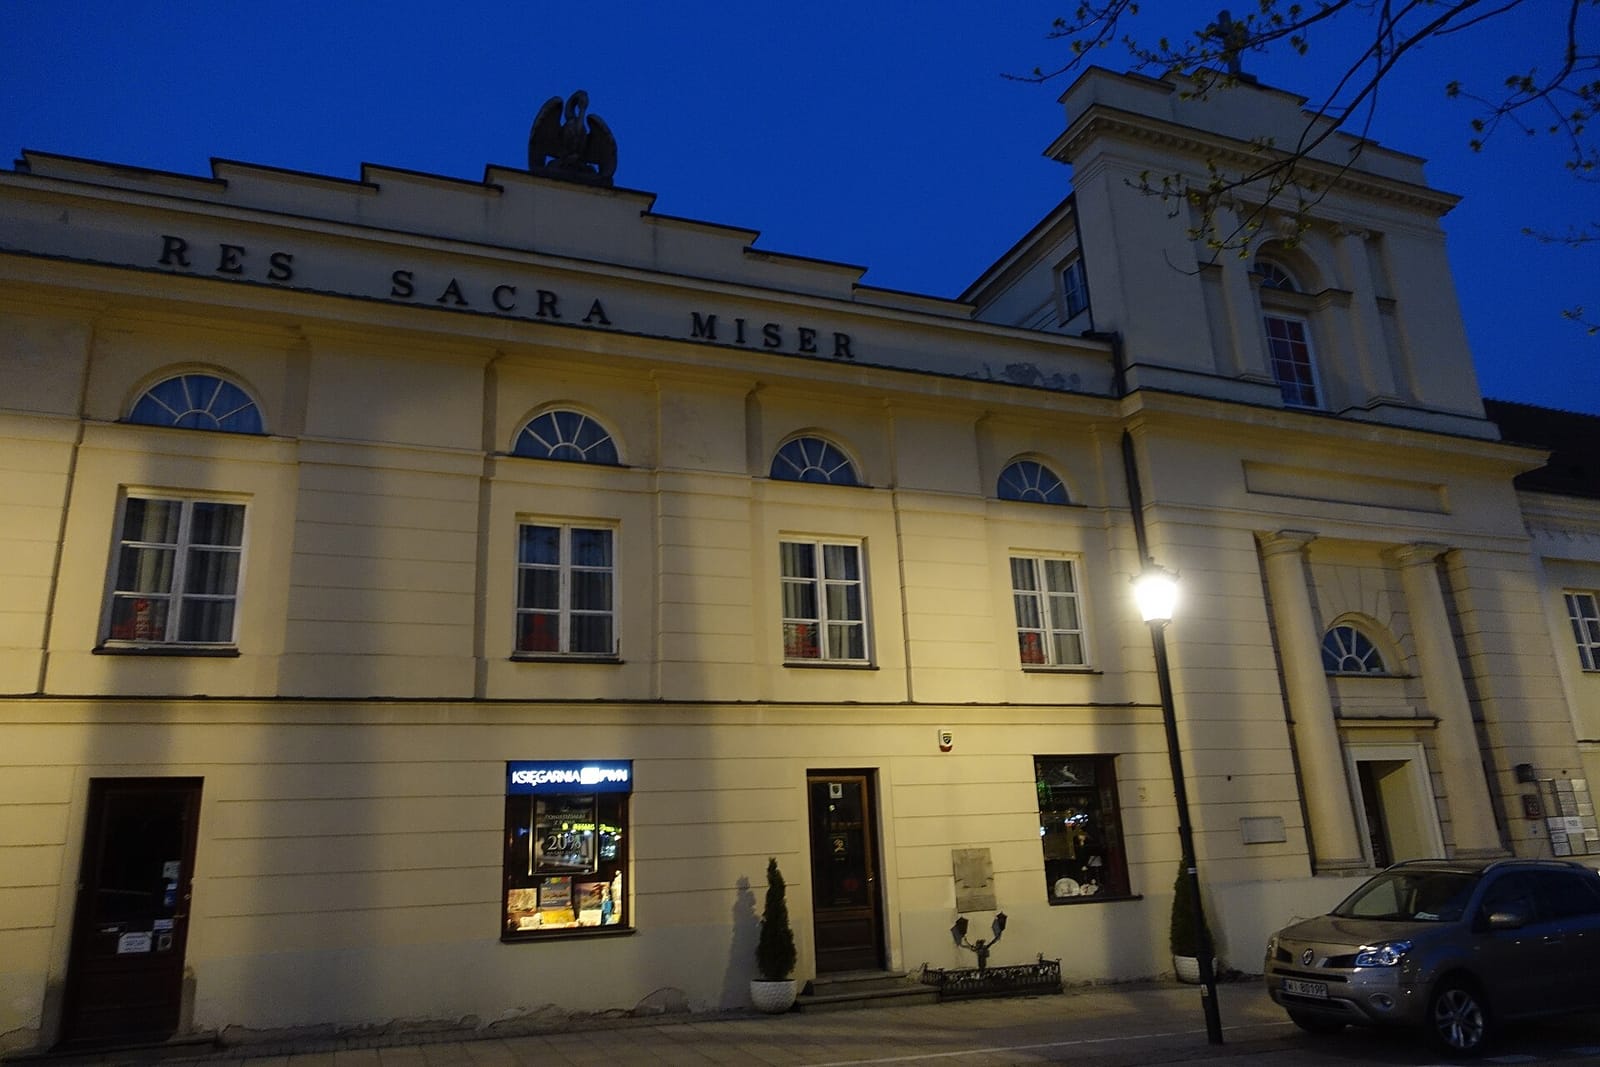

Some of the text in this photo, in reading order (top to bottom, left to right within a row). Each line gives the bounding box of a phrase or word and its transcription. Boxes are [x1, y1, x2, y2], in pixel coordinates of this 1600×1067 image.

[159, 236, 853, 362] RES SACRA MISER
[511, 769, 580, 786] KSIĘGARNIA
[547, 835, 583, 850] 20%
